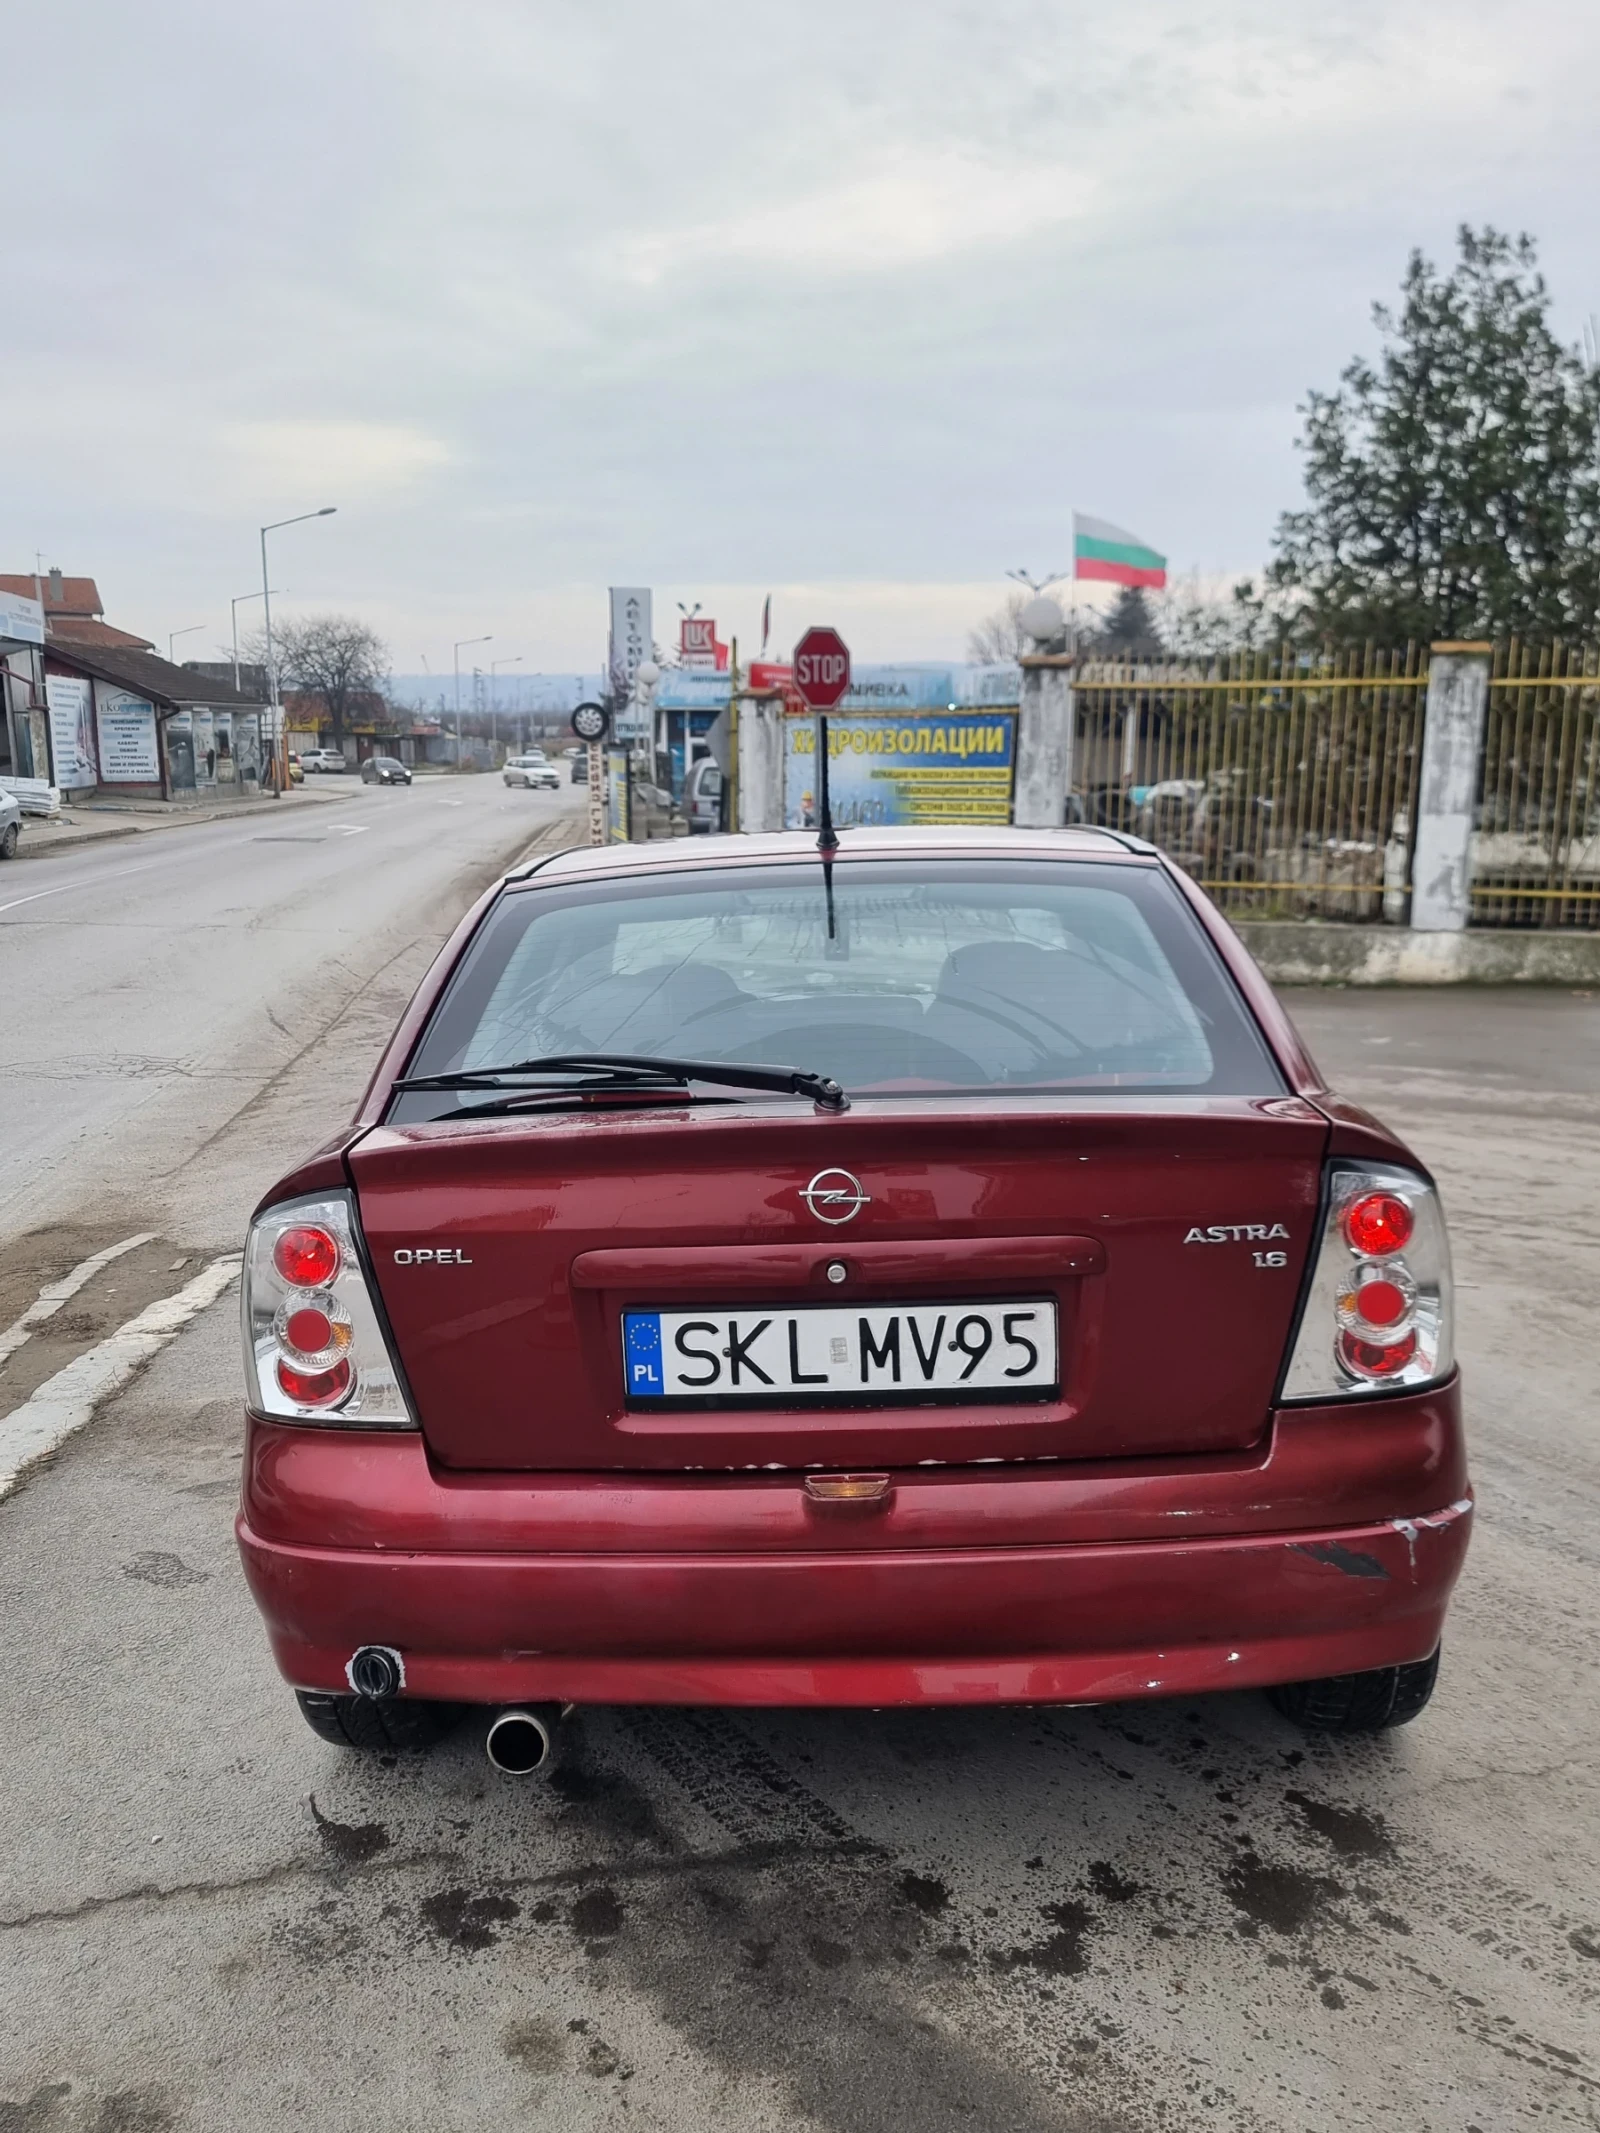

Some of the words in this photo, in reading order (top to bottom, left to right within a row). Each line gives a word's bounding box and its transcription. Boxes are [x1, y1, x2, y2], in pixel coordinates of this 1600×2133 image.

[683, 622, 714, 652] LUK
[798, 654, 846, 684] STOP
[1183, 1223, 1291, 1244] ASTRA
[393, 1248, 473, 1264] OPEL
[633, 1364, 659, 1382] PL
